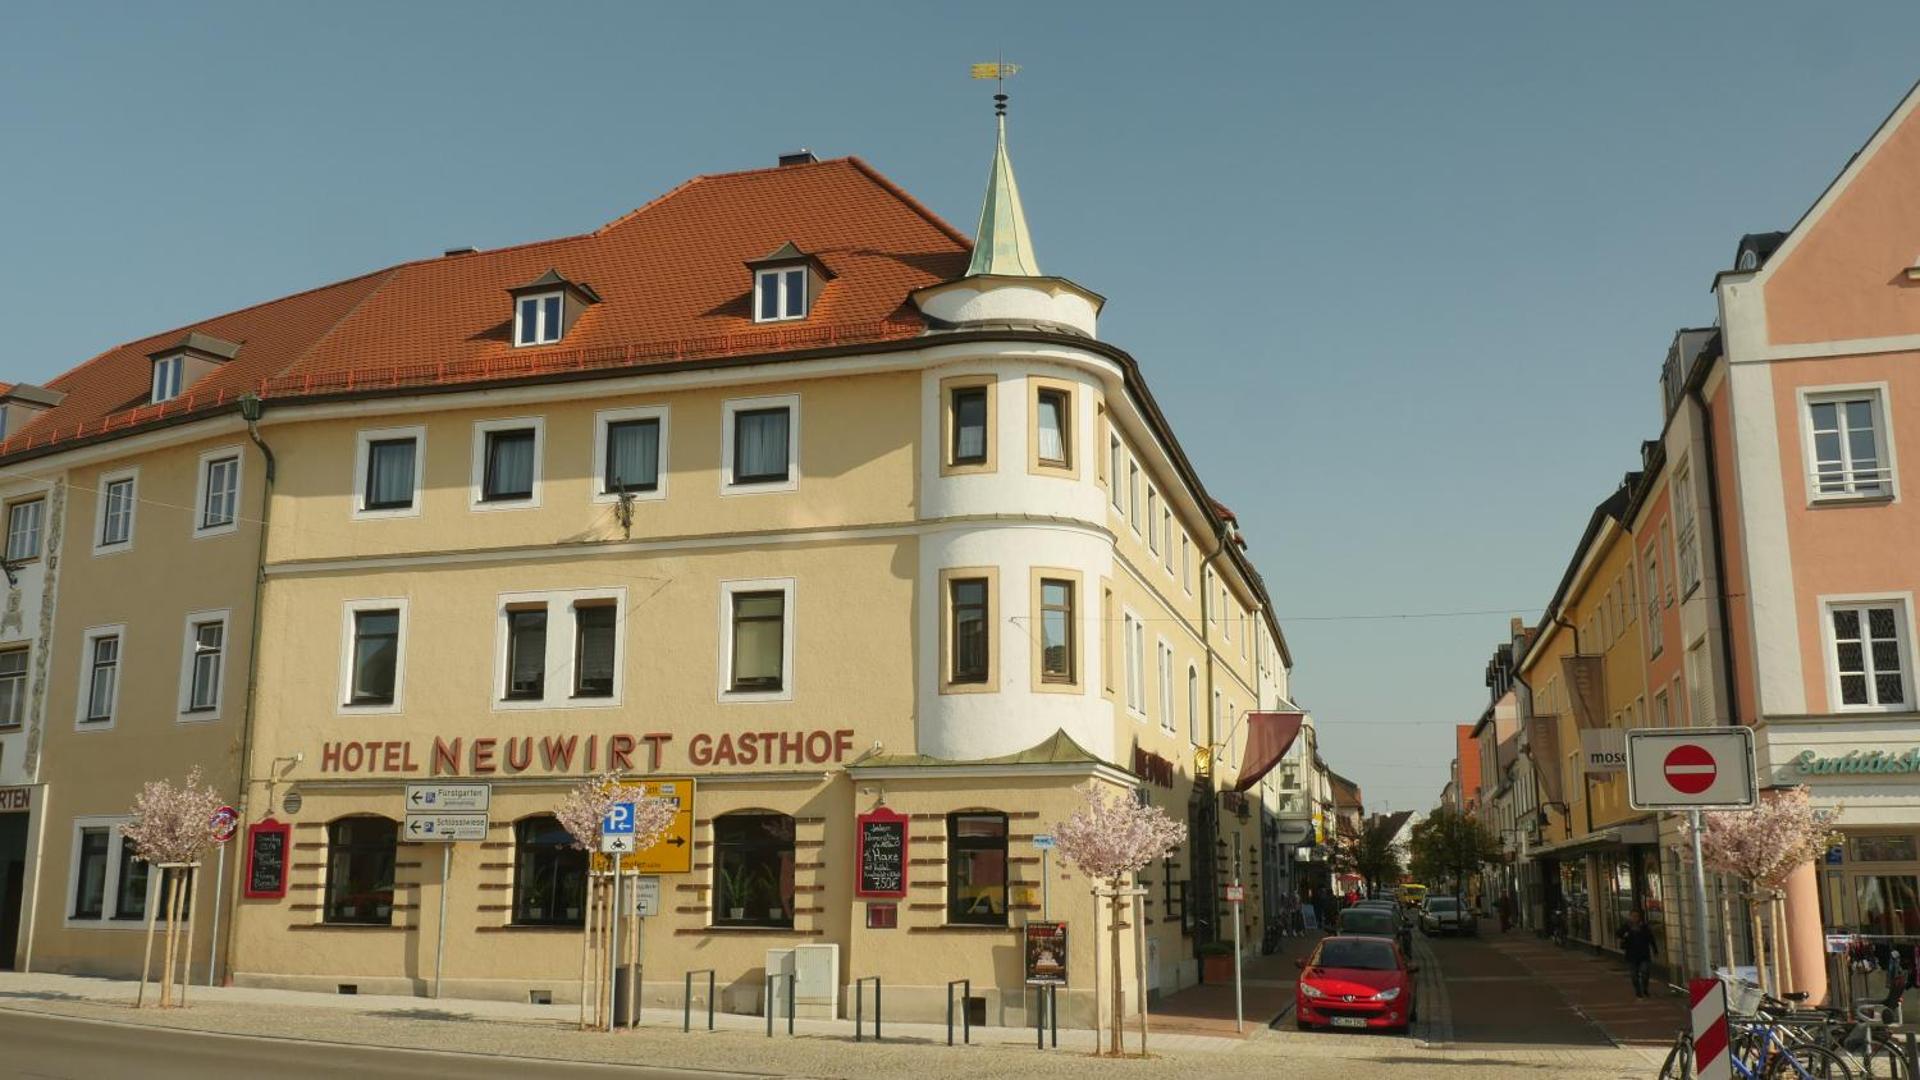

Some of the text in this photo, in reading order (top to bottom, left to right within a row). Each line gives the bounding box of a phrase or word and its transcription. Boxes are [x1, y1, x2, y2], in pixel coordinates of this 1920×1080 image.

[320, 729, 855, 776] HOTEL NEUWIRT GASTHOF
